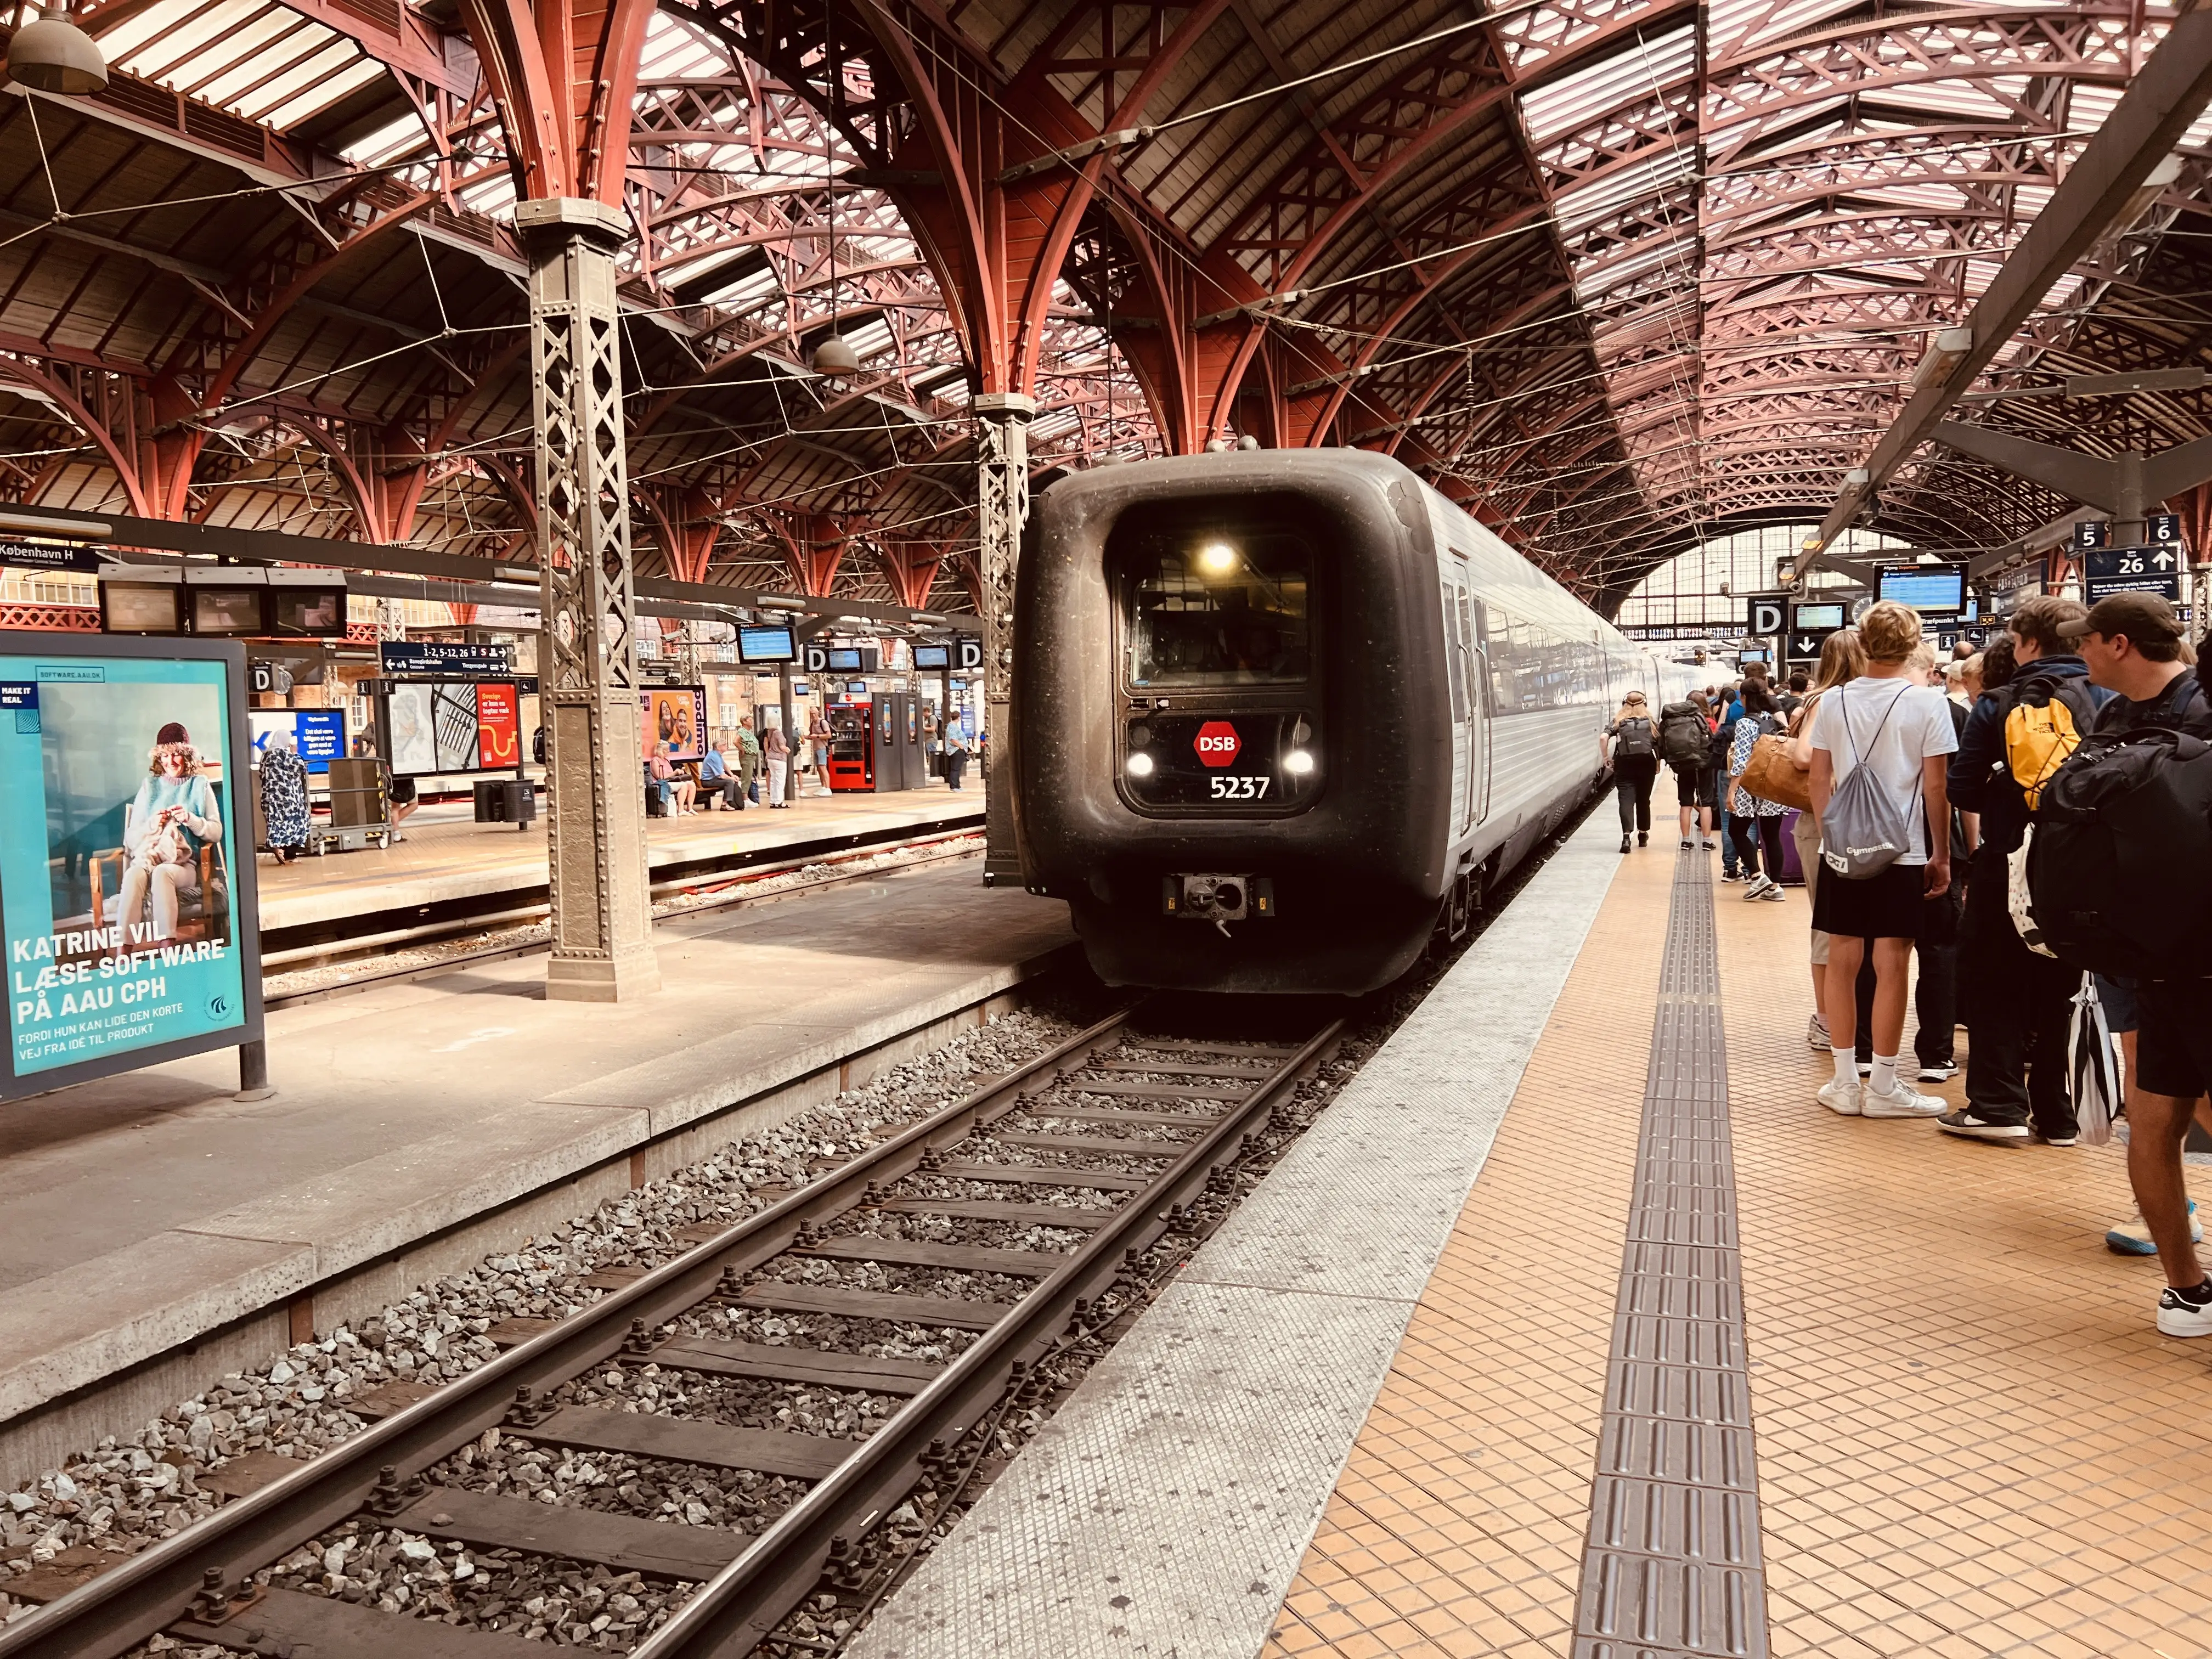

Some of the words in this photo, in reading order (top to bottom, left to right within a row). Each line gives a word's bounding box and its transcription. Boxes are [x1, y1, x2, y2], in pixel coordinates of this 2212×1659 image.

[2083, 532, 2095, 546] 5
[2157, 525, 2170, 540] 6
[0, 544, 61, 559] København
[65, 550, 73, 560] H
[2119, 558, 2144, 574] 26
[1756, 606, 1781, 633] D
[424, 648, 438, 658] 1-2,
[439, 648, 458, 658] 5-12,
[460, 648, 468, 657] 26
[808, 648, 826, 672] D
[962, 644, 980, 667] D
[256, 670, 269, 690] D
[695, 690, 704, 755] podimo
[1200, 736, 1235, 751] DSB
[1211, 776, 1270, 799] 5237
[1846, 842, 1894, 856] Gymnastik
[13, 926, 123, 963] KATRINE
[129, 920, 168, 945] VIL
[15, 960, 92, 994] LÆSE
[99, 938, 225, 979] SOFTWARE
[17, 990, 53, 1024] PÅ
[60, 986, 114, 1017] AAU
[121, 977, 166, 1003] CPH
[18, 1030, 51, 1045] FORDI
[54, 1025, 76, 1038] HUN
[79, 1019, 102, 1032] KAN
[105, 1014, 127, 1028] LIDE
[130, 1009, 150, 1023] DEN
[153, 1003, 183, 1017] KORTE
[19, 1047, 41, 1060] VEJ
[44, 1042, 66, 1055] FRA
[89, 1034, 105, 1046] TIL
[108, 1023, 154, 1042] PRODUKT
